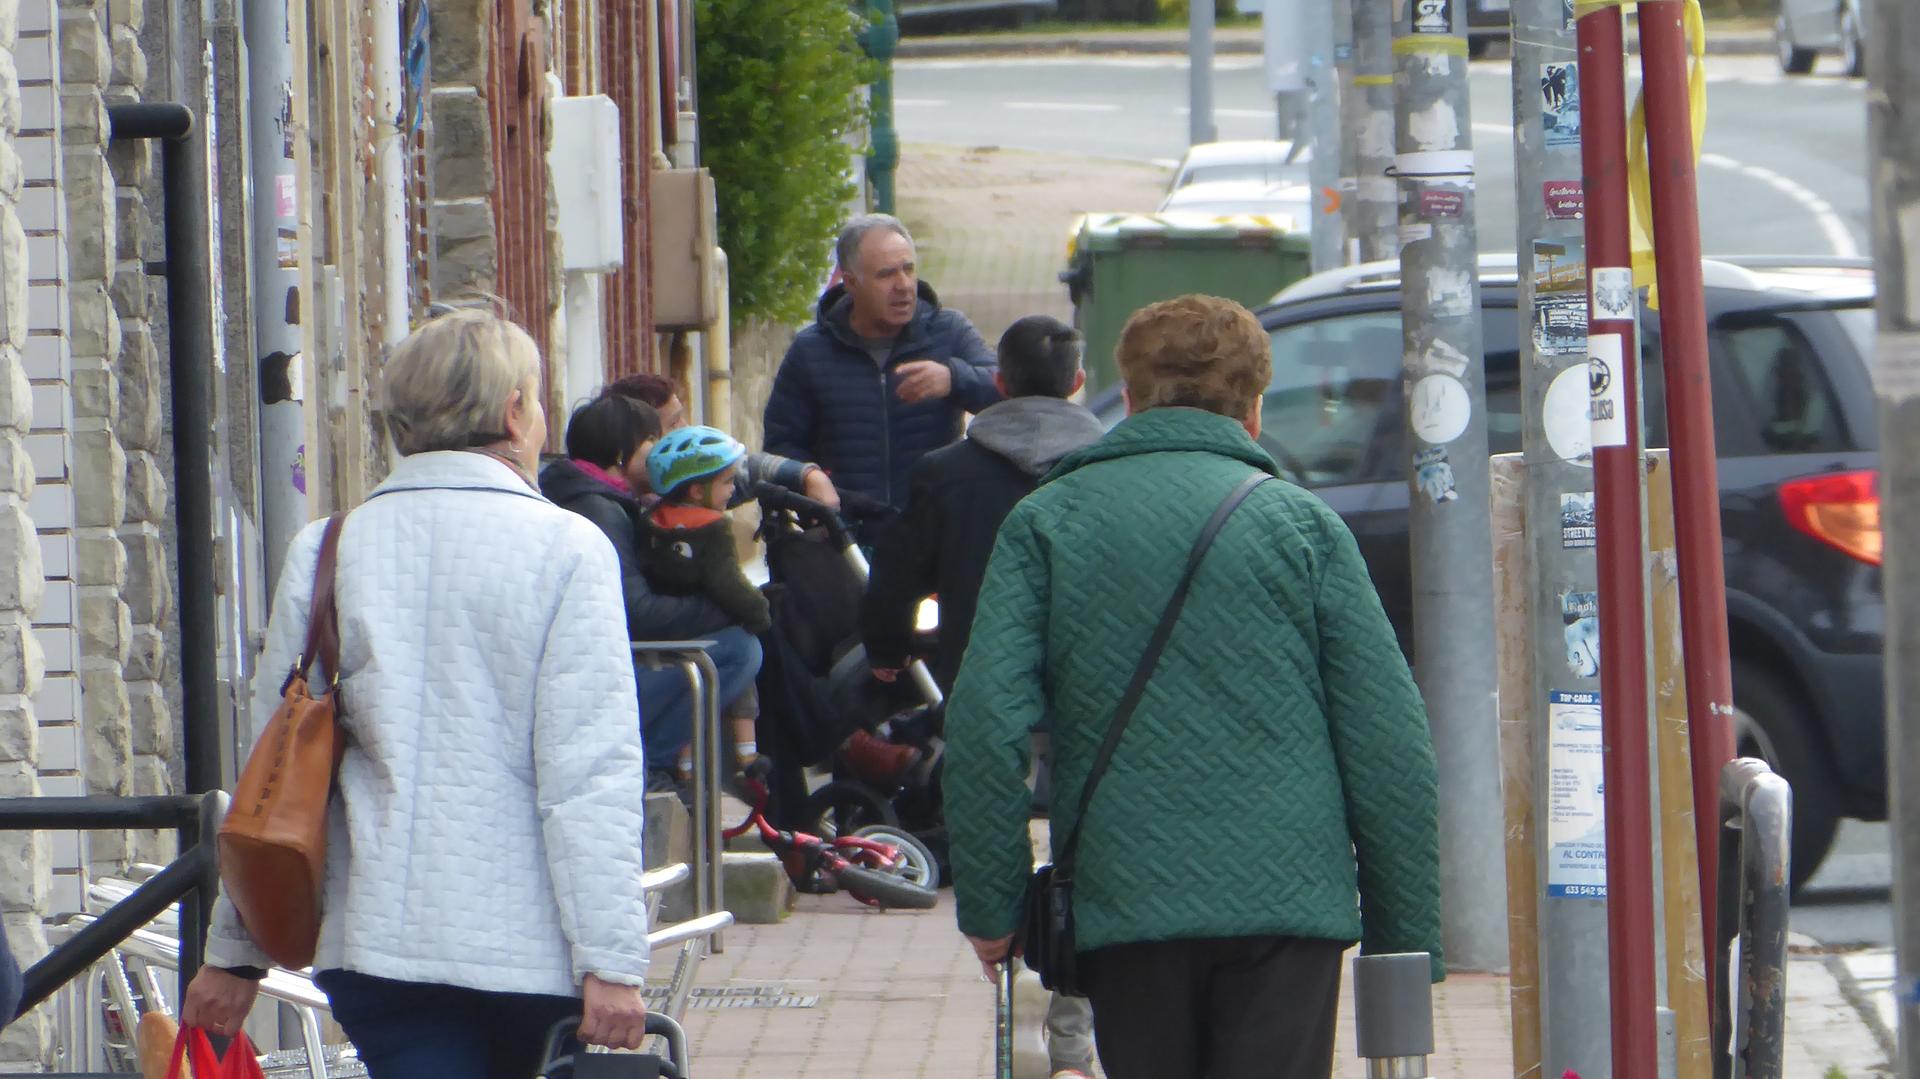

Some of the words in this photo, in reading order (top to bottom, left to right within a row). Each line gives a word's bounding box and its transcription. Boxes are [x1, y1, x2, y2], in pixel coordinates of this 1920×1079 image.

[1560, 693, 1593, 703] TOP-CARS
[1563, 850, 1574, 859] AL
[1565, 885, 1580, 895] 633
